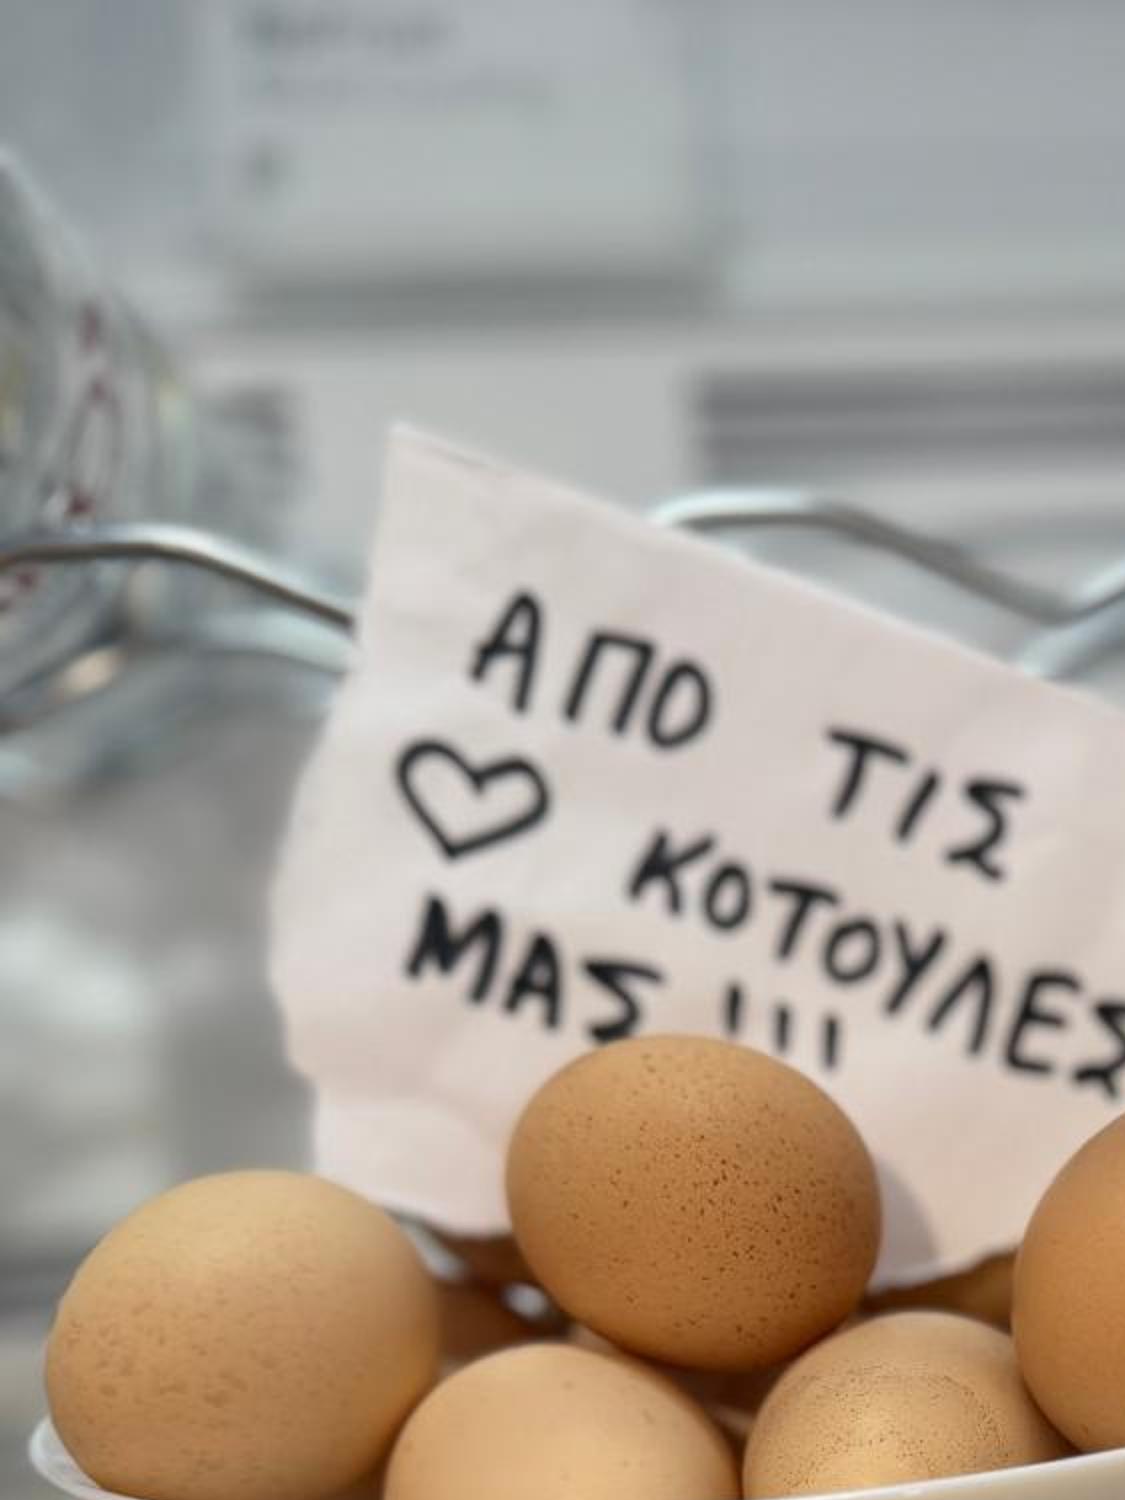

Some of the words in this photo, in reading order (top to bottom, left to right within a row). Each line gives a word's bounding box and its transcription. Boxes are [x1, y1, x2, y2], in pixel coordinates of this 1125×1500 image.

[469, 589, 714, 751] ΑΠΟ
[823, 728, 1027, 882] ΤΙΣ
[402, 889, 664, 1047] ΜΑΣ
